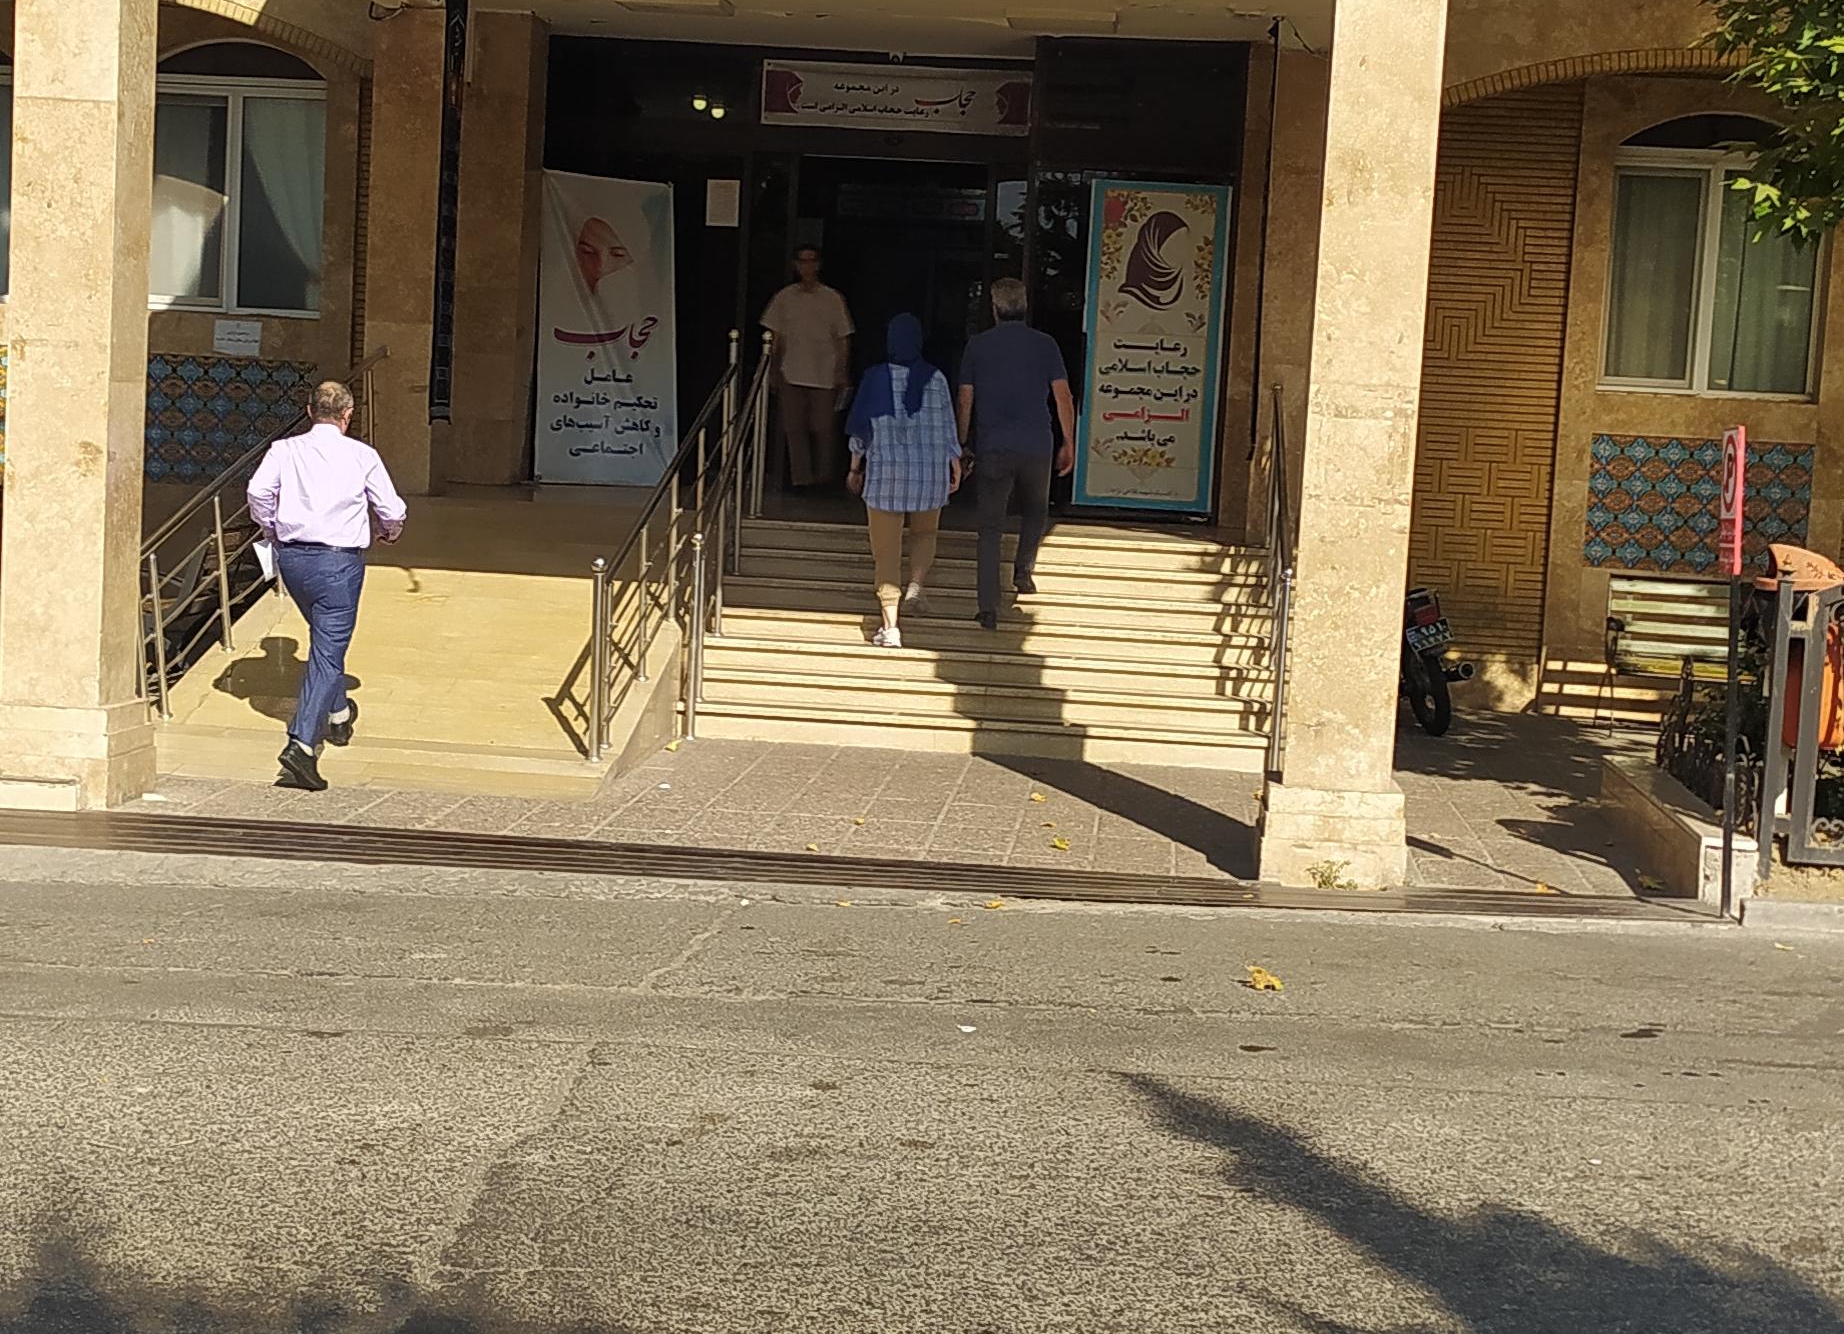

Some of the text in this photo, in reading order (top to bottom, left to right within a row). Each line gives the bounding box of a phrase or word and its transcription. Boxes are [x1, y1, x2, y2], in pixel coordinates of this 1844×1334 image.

[914, 85, 977, 117] حجاب
[553, 316, 659, 360] حجاب
[1113, 338, 1188, 357] رعایت
[584, 367, 633, 385] عامل
[1098, 357, 1201, 380] حجاب اسلامی
[553, 391, 658, 412] تحکیم خانواده
[1098, 383, 1198, 404] در این مجموعه
[1103, 405, 1190, 424] الزامی
[614, 418, 651, 435] کاهش
[654, 426, 661, 439] و
[569, 441, 643, 459] اجتماعی
